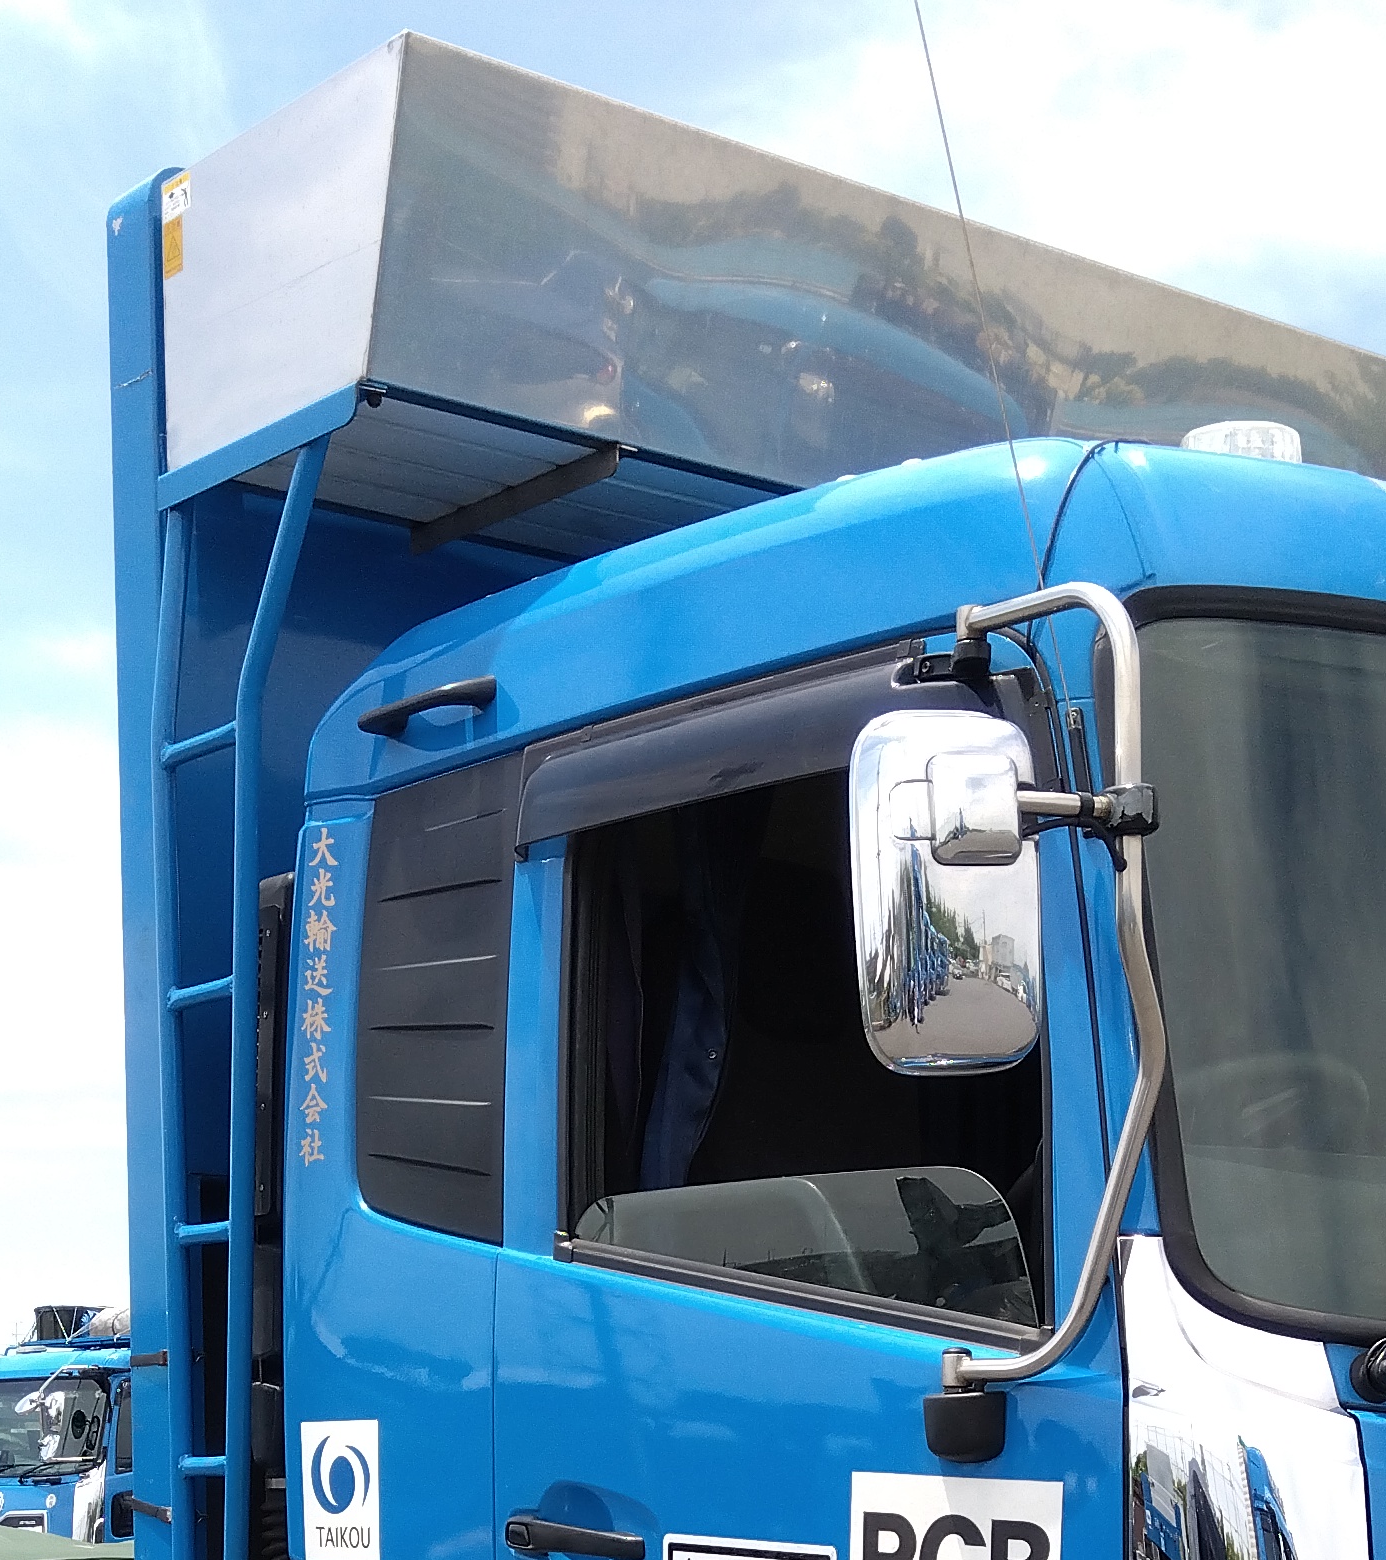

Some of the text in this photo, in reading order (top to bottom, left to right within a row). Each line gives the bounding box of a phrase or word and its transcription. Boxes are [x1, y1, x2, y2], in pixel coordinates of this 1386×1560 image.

[299, 827, 339, 1167] 大光輸送株式会社
[315, 1526, 370, 1549] TAIKOU
